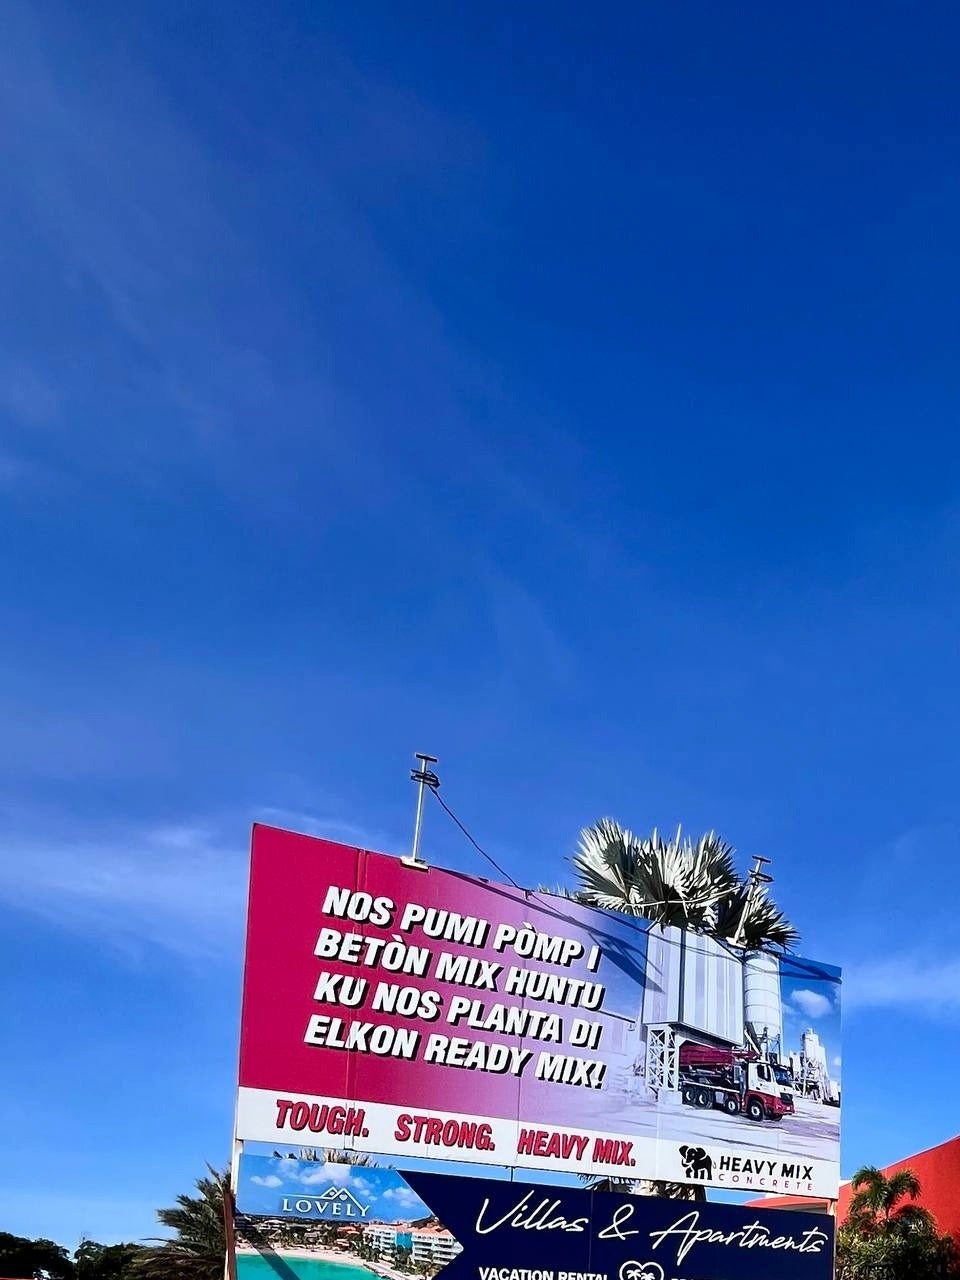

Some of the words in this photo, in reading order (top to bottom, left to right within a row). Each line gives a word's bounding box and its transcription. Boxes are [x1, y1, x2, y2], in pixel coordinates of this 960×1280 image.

[321, 885, 395, 927] NOS
[400, 903, 488, 947] PUMI
[493, 922, 583, 965] PÒMP
[586, 945, 600, 972] I
[313, 927, 431, 976] BETÒN
[435, 952, 501, 989] MIX
[505, 966, 604, 1010] HUNTU
[313, 971, 367, 1007] KU
[371, 982, 441, 1019] NOS
[446, 995, 562, 1043] PLANTA
[569, 1018, 603, 1049] DI
[303, 1014, 419, 1060] ELKON
[424, 1034, 532, 1075] READY
[535, 1052, 608, 1089] MIX!
[275, 1099, 369, 1137] TOUGH.
[394, 1114, 495, 1150] STRONG.
[517, 1128, 589, 1161] HEAVY
[592, 1138, 636, 1166] MIX.
[719, 1156, 777, 1175] HEAVY
[781, 1163, 813, 1180] MIX
[283, 1198, 370, 1217] LOVELY
[718, 1173, 813, 1190] CONCRETE
[475, 1190, 589, 1234] Villas
[598, 1204, 640, 1241] &
[649, 1211, 828, 1266] Apartments
